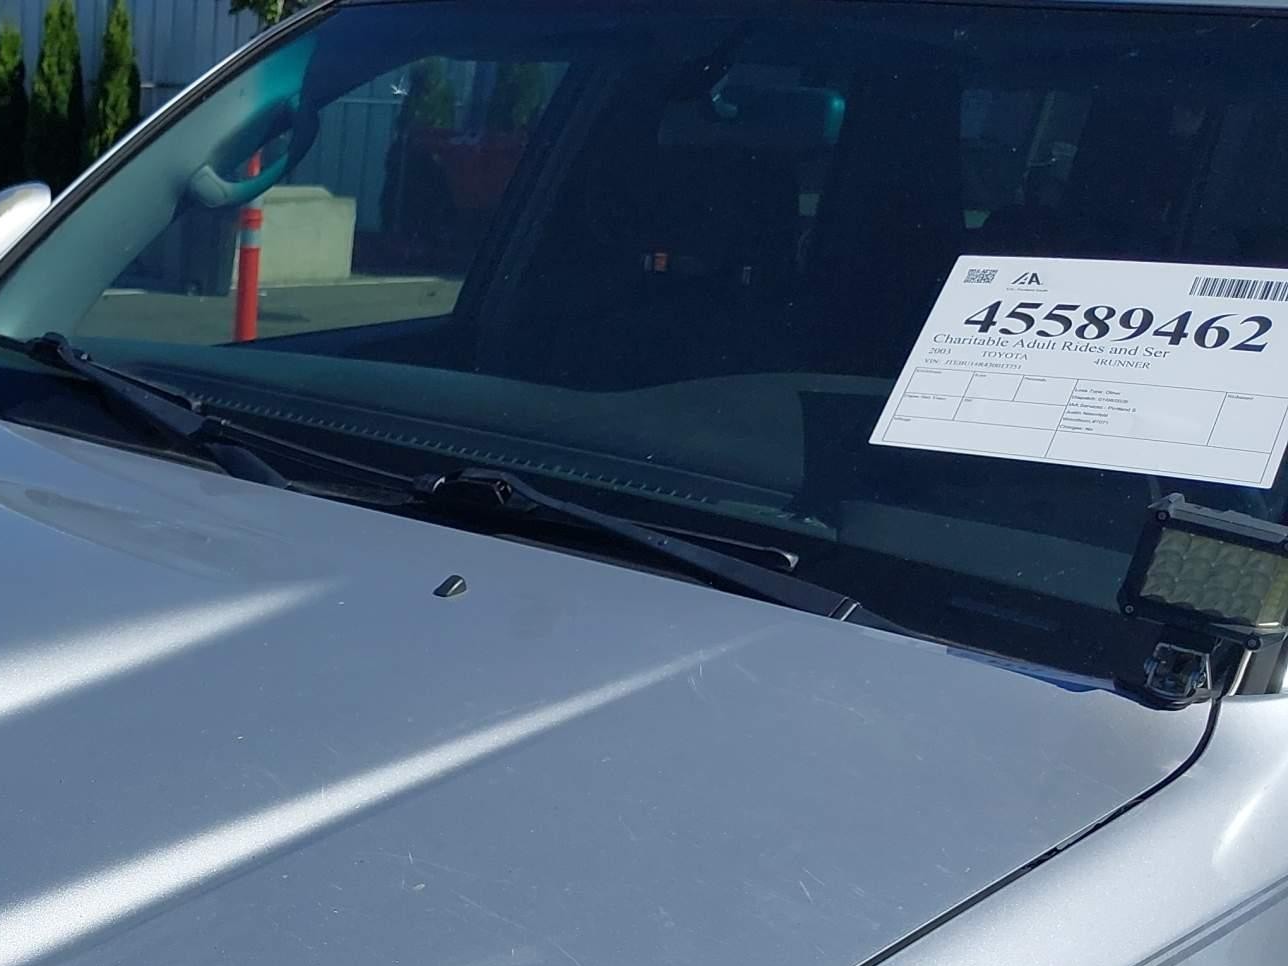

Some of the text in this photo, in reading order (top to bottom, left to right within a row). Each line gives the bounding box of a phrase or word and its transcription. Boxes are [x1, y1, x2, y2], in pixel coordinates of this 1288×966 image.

[963, 300, 1273, 353] 45589462
[928, 347, 1151, 369] 2003 TOYOTA 4RUNNER
[933, 333, 1170, 358] Charitable Adult Rides and Ser
